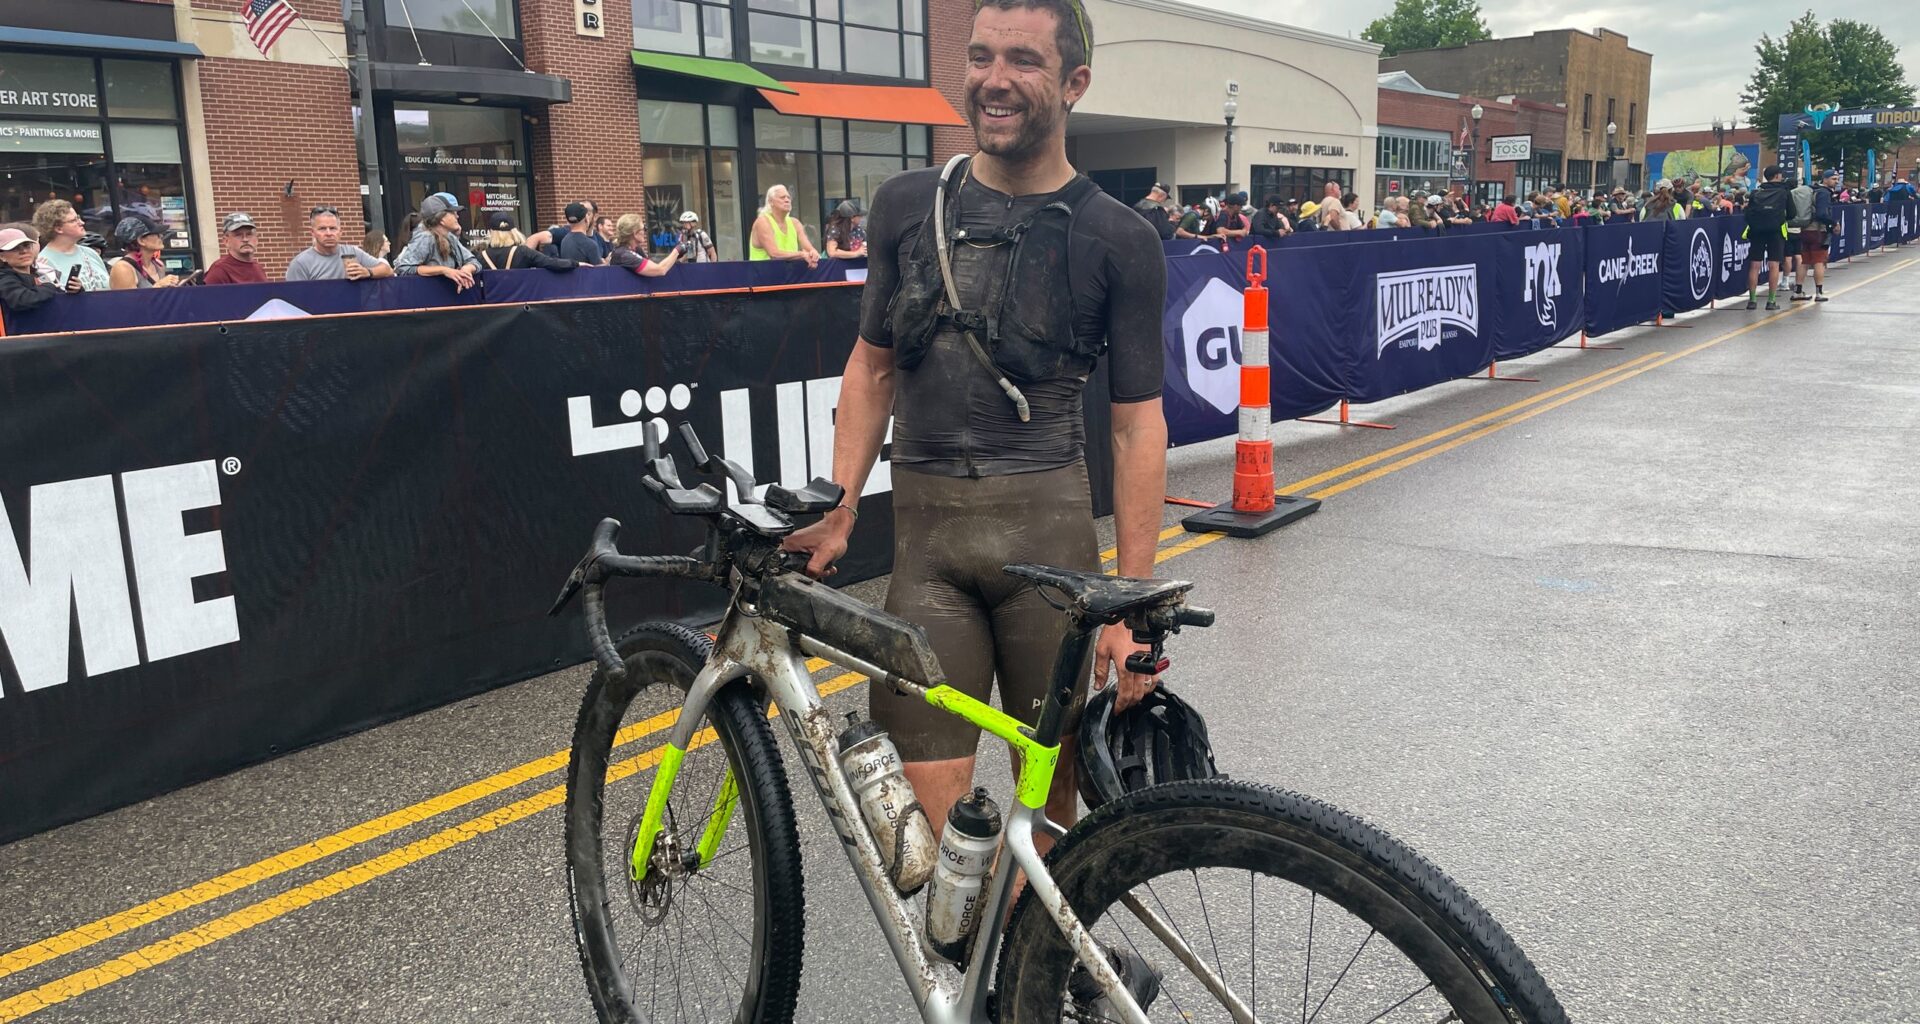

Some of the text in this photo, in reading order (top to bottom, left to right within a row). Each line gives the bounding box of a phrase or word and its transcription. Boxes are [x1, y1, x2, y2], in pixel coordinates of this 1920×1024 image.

[21, 91, 49, 106] ART
[52, 92, 97, 108] STORE
[19, 127, 64, 138] PAINTINGS
[65, 129, 72, 138] &
[73, 129, 100, 139] MORE!
[1268, 141, 1344, 157] PLUMBING BY SPELLMAN
[1495, 144, 1528, 155] TOSO
[404, 156, 433, 165] EDUCATE,
[433, 157, 463, 165] ADVOCATE
[468, 158, 498, 166] CELEBRATE
[1598, 252, 1660, 283] CANE CREEK
[1379, 274, 1475, 338] MULREADY'S
[1420, 318, 1438, 340] PUB
